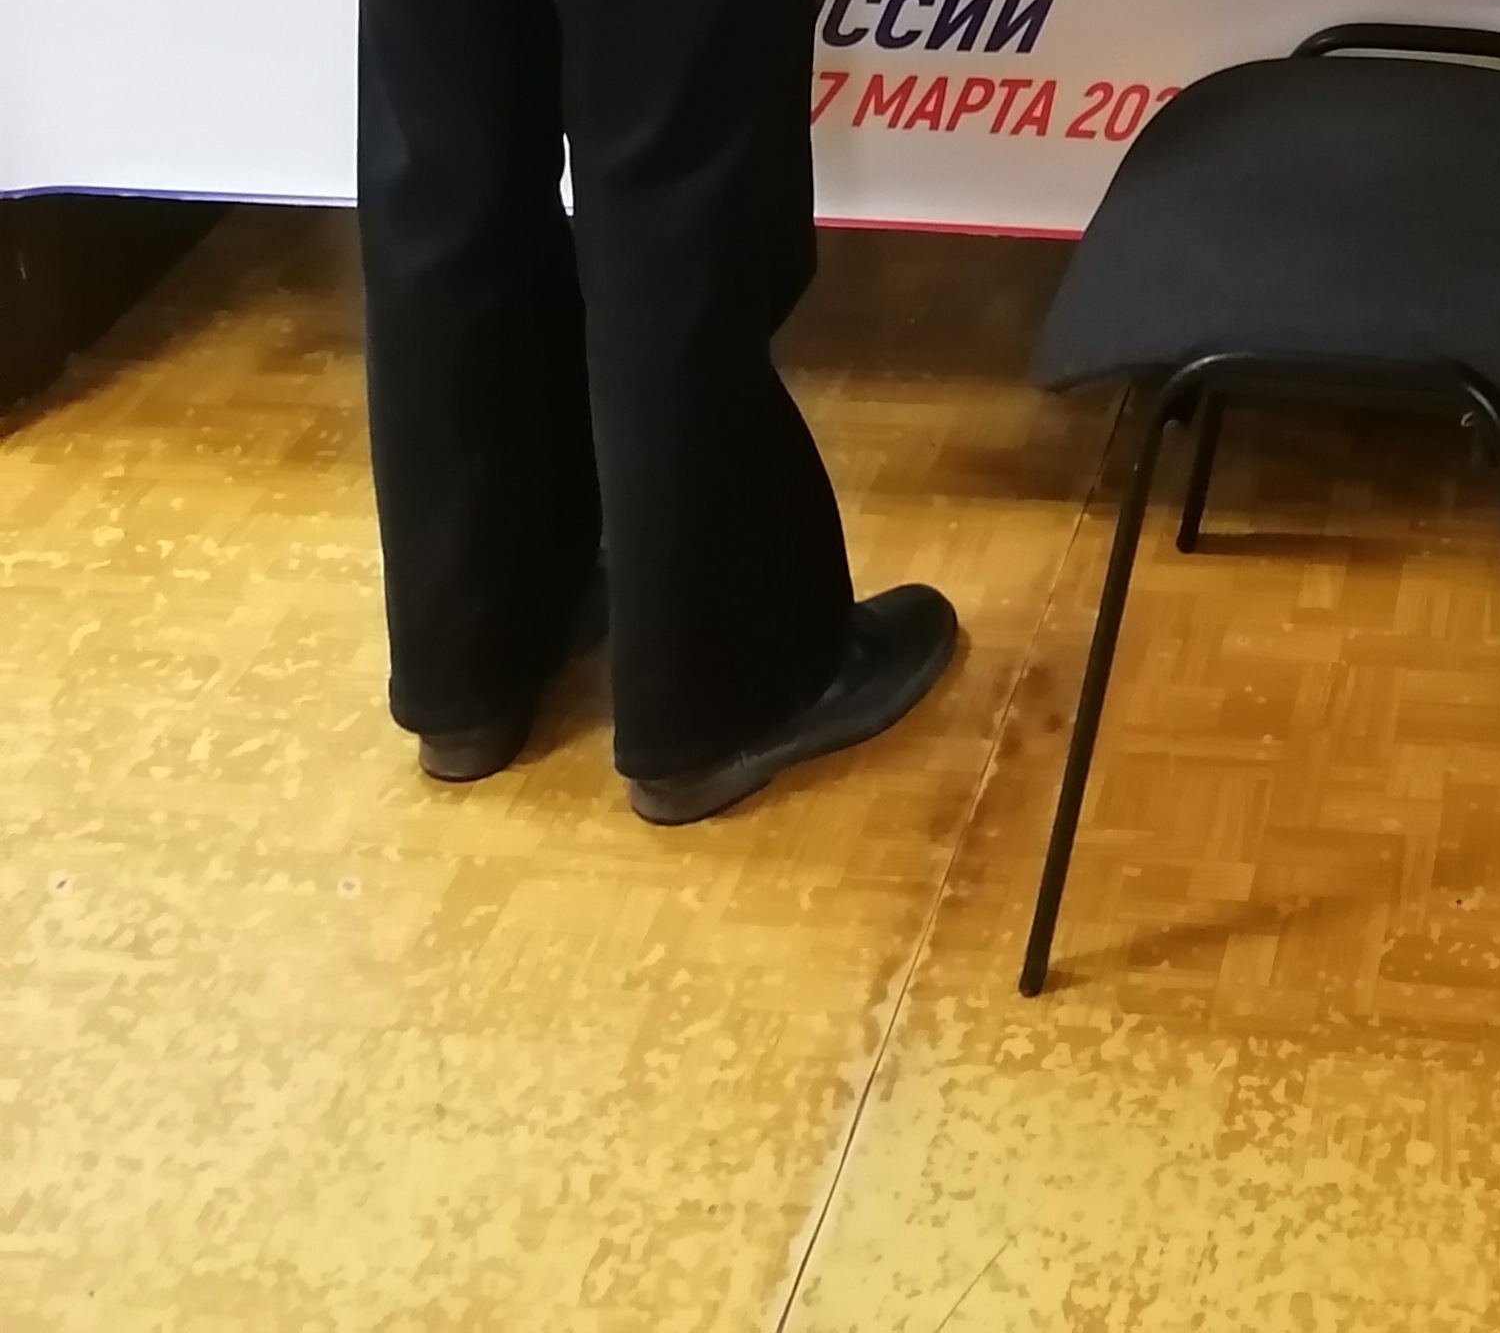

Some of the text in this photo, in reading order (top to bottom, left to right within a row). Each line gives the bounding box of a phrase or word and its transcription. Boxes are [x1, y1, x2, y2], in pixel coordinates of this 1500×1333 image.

[812, 71, 1182, 142] 7 МАРТА 20
